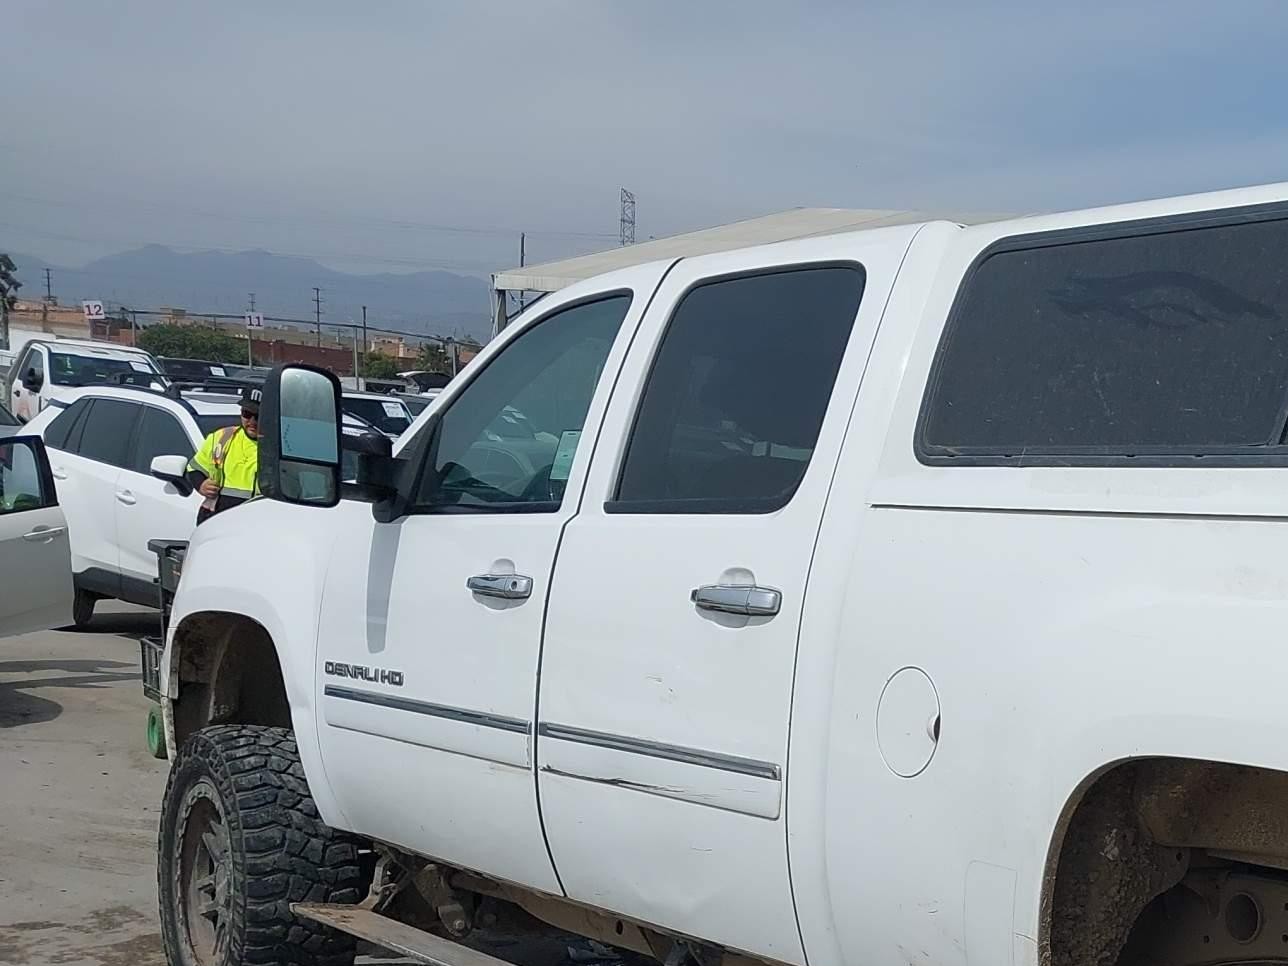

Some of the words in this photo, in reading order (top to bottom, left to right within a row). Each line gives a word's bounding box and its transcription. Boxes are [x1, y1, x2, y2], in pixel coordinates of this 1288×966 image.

[84, 304, 102, 316] 12
[248, 315, 263, 327] 11
[324, 661, 380, 683] DENALI
[380, 669, 404, 686] HD
